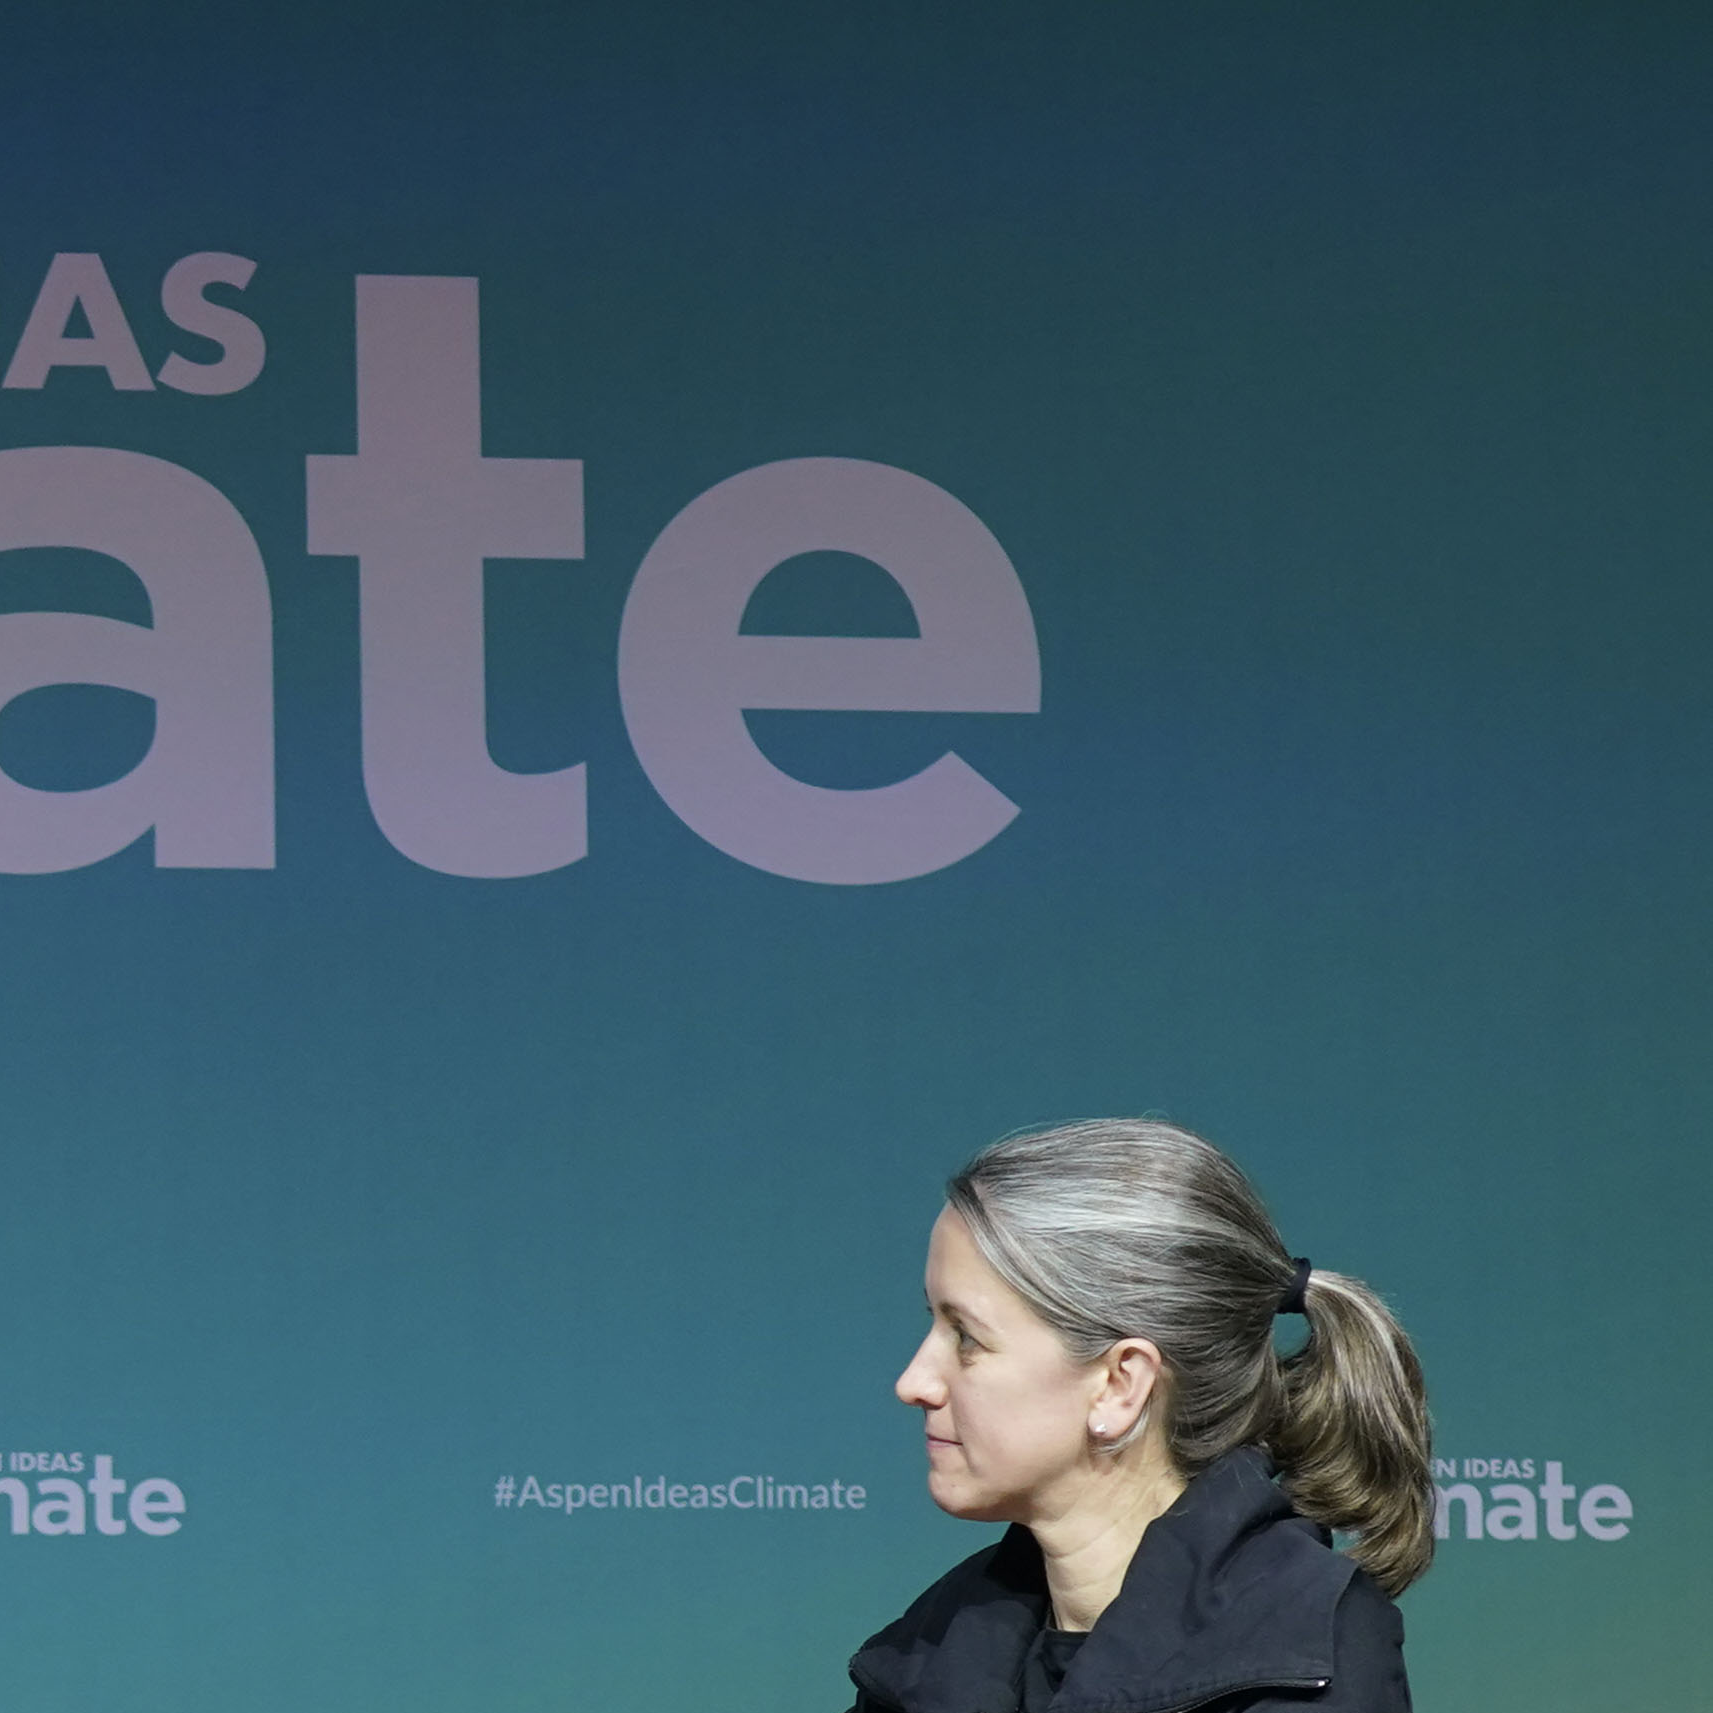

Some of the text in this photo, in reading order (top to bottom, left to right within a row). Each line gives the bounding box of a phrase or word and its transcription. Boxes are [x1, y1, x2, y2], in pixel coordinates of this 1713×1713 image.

[10, 1452, 85, 1473] IDEAS
[1464, 1458, 1535, 1479] IDEAS
[494, 1475, 867, 1515] #AspenIdeasClimate
[1434, 1460, 1634, 1542] mate
